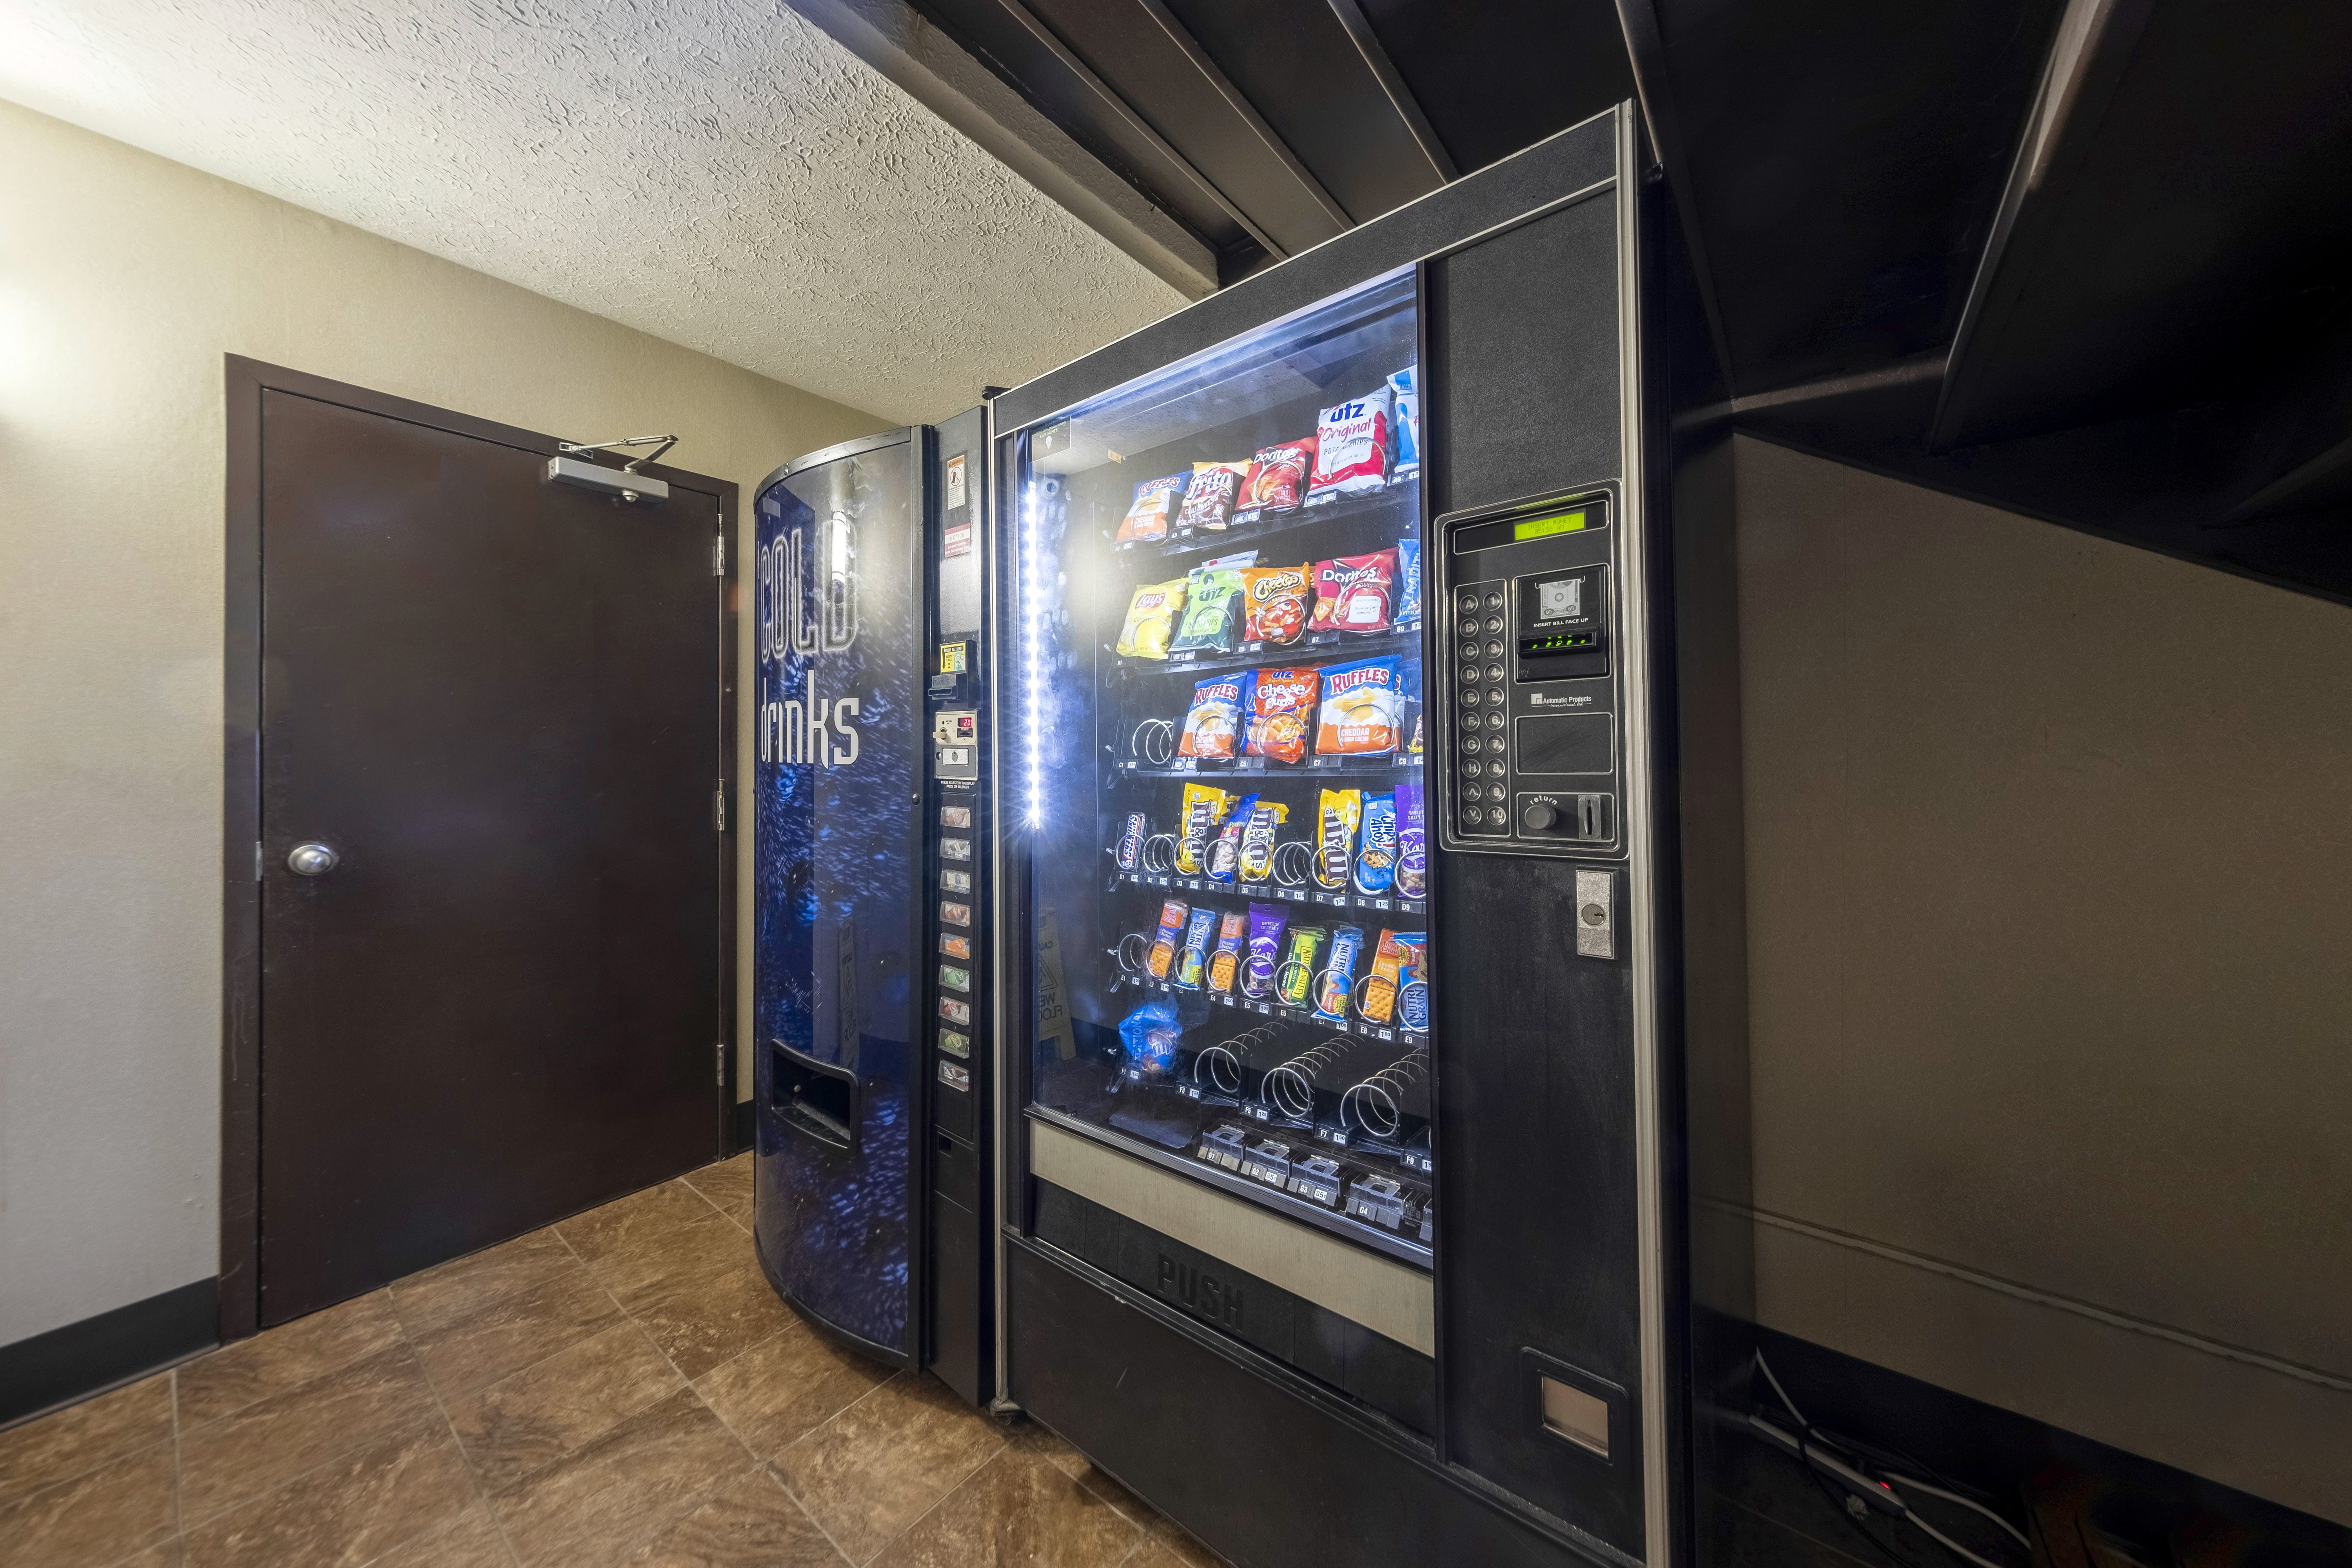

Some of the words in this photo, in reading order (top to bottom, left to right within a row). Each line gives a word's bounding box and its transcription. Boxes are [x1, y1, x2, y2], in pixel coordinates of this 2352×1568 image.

[1323, 418, 1372, 442] Original
[1324, 444, 1347, 455] POTAO
[1349, 439, 1368, 448] CHIPS
[1186, 472, 1232, 499] Frito
[1528, 521, 1549, 530] INSERT
[1553, 517, 1572, 526] MONEY
[1535, 526, 1553, 534] 05:55
[950, 532, 964, 541] NOTICE
[1322, 567, 1377, 583] Doritos
[761, 518, 858, 664] COLD
[1254, 573, 1300, 601] Cheetos
[1138, 593, 1164, 608] Lay's
[1465, 600, 1475, 609] A
[1490, 597, 1495, 605] 1
[1466, 624, 1474, 632] B
[1490, 621, 1497, 629] 2
[1466, 646, 1474, 656] C
[1490, 644, 1497, 653] 3
[1467, 670, 1475, 679] D
[1491, 668, 1498, 677] 4
[1332, 669, 1389, 694] RUFFLES
[1195, 685, 1238, 705] RUFFLES
[1257, 683, 1305, 699] Cheese
[1468, 694, 1475, 702] E
[1492, 692, 1498, 701] 5
[761, 670, 858, 769] drinks
[1468, 717, 1475, 726] F
[1492, 716, 1498, 725] 6
[1341, 728, 1370, 737] CHEDDAR
[1468, 740, 1476, 749] G
[1492, 740, 1499, 748] 7
[1469, 764, 1476, 773] H
[1493, 764, 1499, 773] 8
[1494, 788, 1500, 797] 9
[1530, 795, 1558, 805] return
[1492, 811, 1504, 820] 10
[1124, 815, 1137, 857] SNICKERS
[1381, 946, 1398, 955] Chee
[1338, 944, 1349, 972] NUTRI
[1407, 989, 1419, 1019] NUTRI
[1415, 989, 1426, 1020] GRAIN
[1158, 1252, 1243, 1333] PUSH
